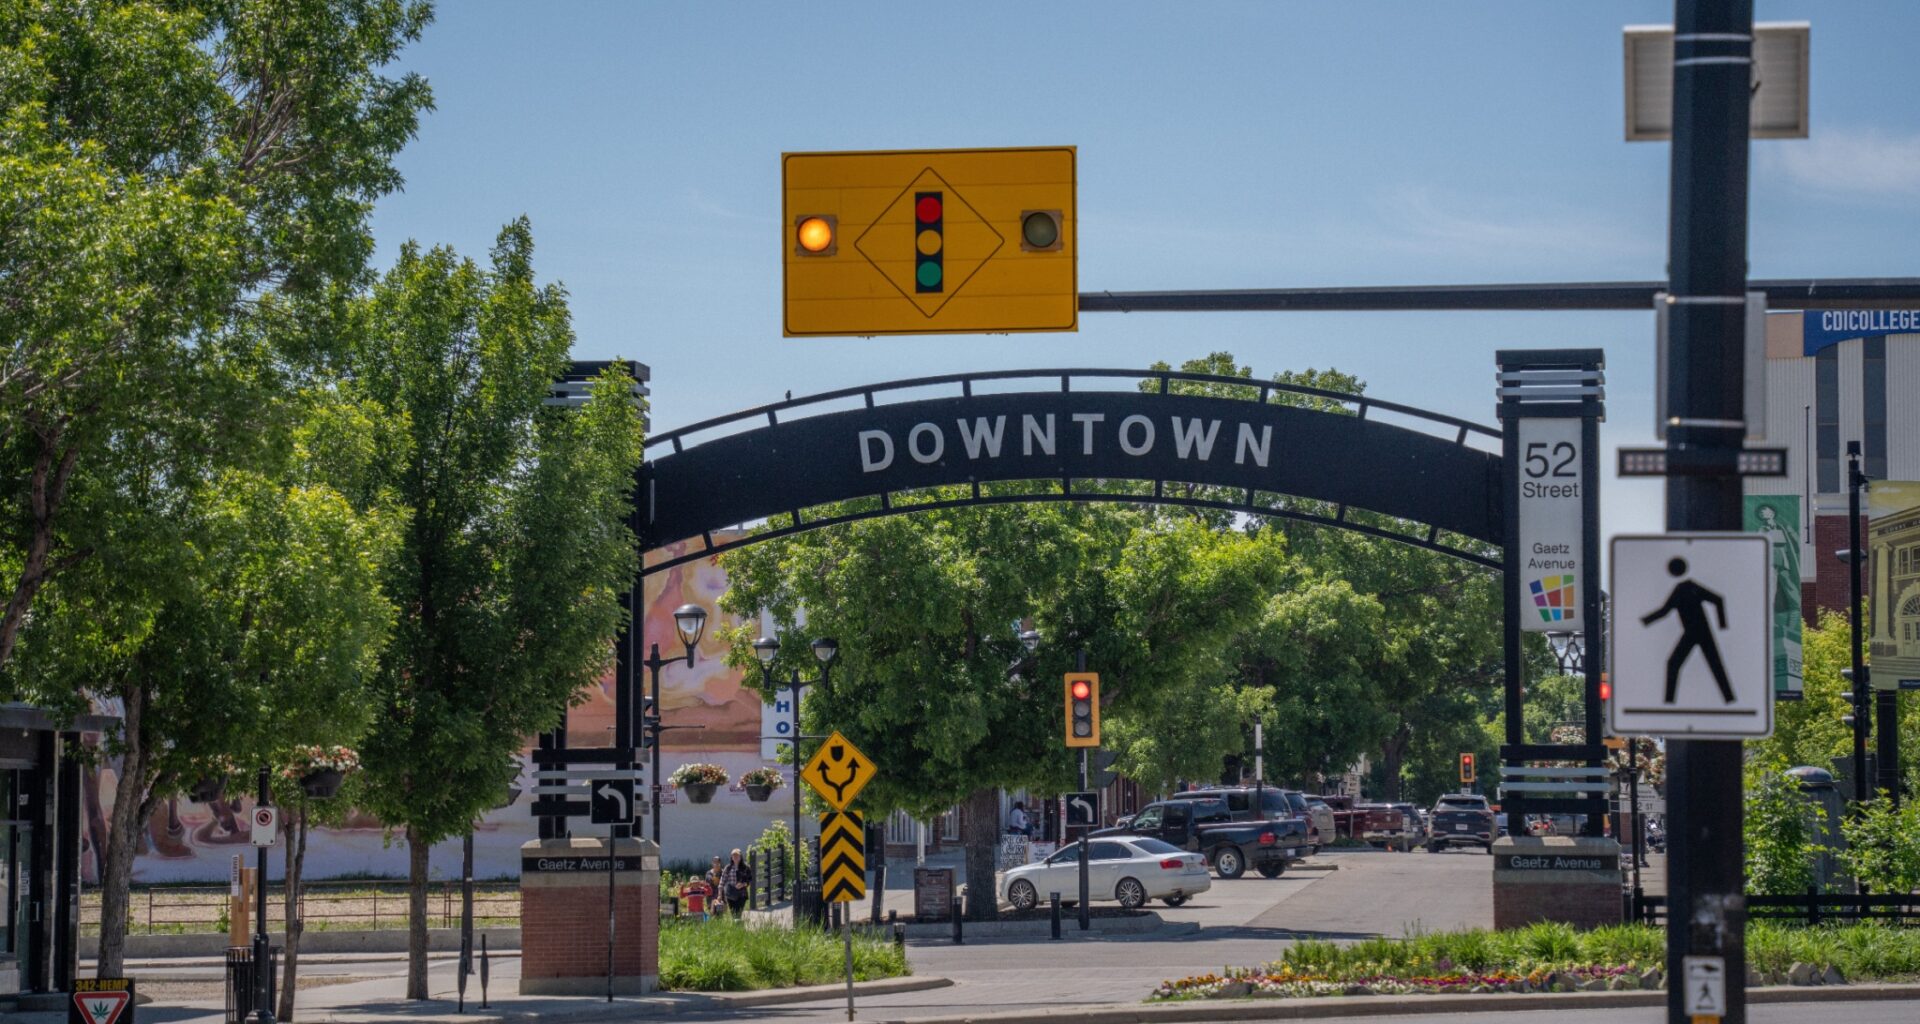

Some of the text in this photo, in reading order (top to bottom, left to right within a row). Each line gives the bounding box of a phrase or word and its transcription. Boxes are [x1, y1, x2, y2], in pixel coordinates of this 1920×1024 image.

[858, 413, 1273, 473] DOWNTOWN
[1524, 441, 1578, 478] 52
[1522, 480, 1580, 499] Street
[1532, 543, 1570, 554] Gaetz
[1528, 557, 1576, 570] Avenue
[537, 858, 576, 871] Gaetz
[1510, 856, 1602, 870] Gaetz Avenue
